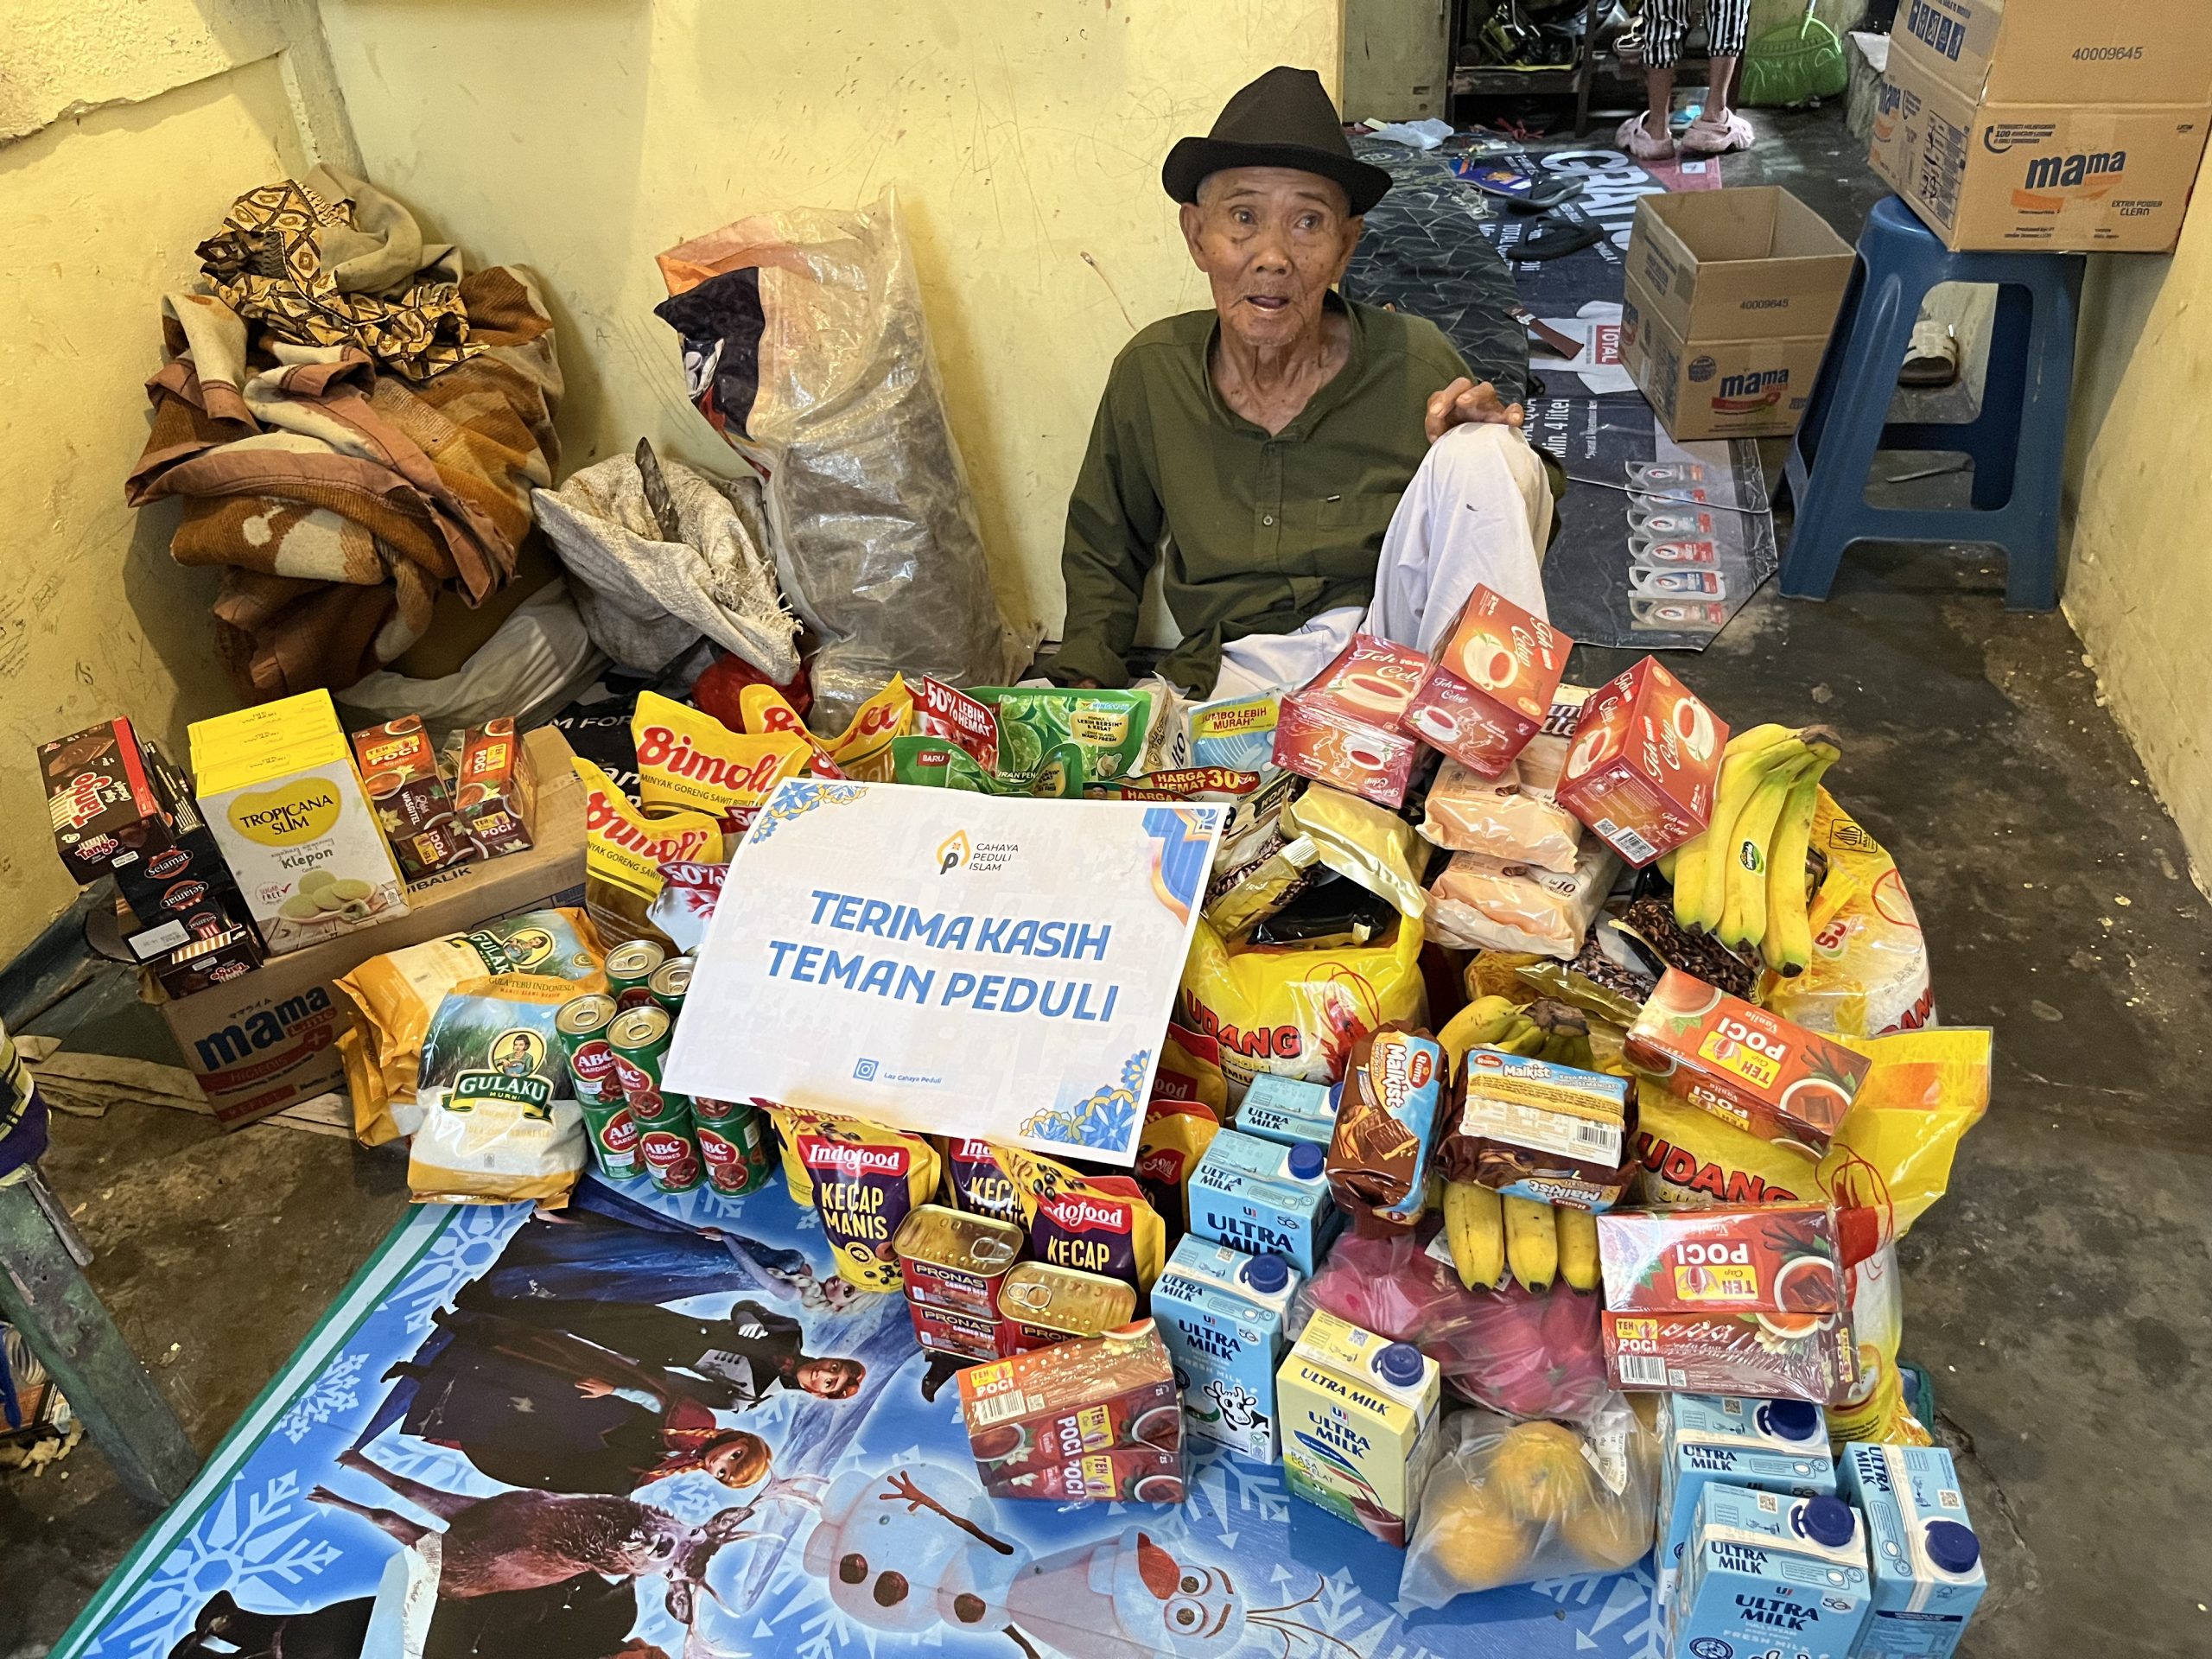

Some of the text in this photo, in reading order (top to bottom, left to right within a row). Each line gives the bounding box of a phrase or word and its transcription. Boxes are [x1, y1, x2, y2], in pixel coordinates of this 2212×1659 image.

[2072, 47, 2143, 60] 40009645
[2024, 150, 2126, 189] mama
[1499, 223, 1522, 245] TOTAL
[1740, 298, 1789, 309] 40009645
[1601, 327, 1620, 363] TOTAL
[1719, 368, 1789, 397] mama
[1353, 650, 1395, 664] Teh
[1433, 678, 1453, 690] Teh
[1441, 690, 1469, 703] Celup
[958, 701, 985, 724] LEBIH
[1202, 707, 1267, 724] JUMBO LEBIH
[368, 746, 388, 756] TEH
[371, 746, 419, 766] POCI
[474, 748, 487, 774] POCI
[922, 753, 945, 763] BARU
[640, 773, 672, 790] MINYAK
[674, 784, 709, 800] GORENG
[1157, 770, 1206, 783] HARGA
[71, 772, 113, 830] Tango
[1128, 790, 1173, 801] HARGA
[239, 794, 334, 829] TROPICANA
[400, 791, 422, 826] WASGITEL
[271, 815, 310, 836] SLIM
[474, 817, 488, 827] TEH
[480, 824, 512, 838] POCI
[75, 838, 118, 861] Tango
[428, 830, 448, 857] POCI
[976, 842, 1019, 852] CAHAYA
[281, 849, 334, 870] Klepon
[588, 842, 640, 872] NYAK GORENG
[969, 862, 1002, 872] ISLAM
[973, 853, 1012, 861] PEDULI
[665, 864, 727, 887] 50%
[260, 885, 279, 896] SUGAR
[263, 892, 283, 901] FREE
[1557, 880, 1576, 894] 10
[808, 890, 1112, 962] TERIMA KASIH
[210, 962, 251, 981] Tango
[767, 940, 1120, 1023] TEMAN PEDULI
[488, 977, 575, 992] GULA TEBU INDONESIA
[194, 986, 332, 1071] mama
[1186, 988, 1303, 1059] UDANG
[1717, 1017, 1787, 1061] POCI
[577, 1048, 613, 1067] ABC
[1477, 1058, 1499, 1066] Roma
[1384, 1043, 1408, 1109] Malkist
[1414, 1054, 1427, 1087] Roma
[1503, 1064, 1552, 1079] Malkist
[1740, 1059, 1772, 1084] TEH
[459, 1076, 548, 1101] GULAKU
[489, 1091, 521, 1101] MURNI
[1694, 1085, 1749, 1120] POCI
[1248, 1107, 1289, 1125] ULTRA
[1248, 1116, 1281, 1130] MILK
[645, 1141, 681, 1154] ABC
[809, 1145, 899, 1173] Indofood
[1640, 1133, 1798, 1202] UDANG
[1199, 1175, 1235, 1192] MILK
[1200, 1165, 1243, 1186] ULTRA
[821, 1181, 884, 1213] KECAP
[970, 1177, 1022, 1210] KECA
[1528, 1180, 1602, 1202] Malkist
[1045, 1199, 1122, 1227] dofood
[823, 1211, 888, 1241] MANIS
[1207, 1212, 1294, 1253] ULTRA
[1047, 1236, 1110, 1268] KECAP
[1677, 1243, 1749, 1266] POCI
[916, 1264, 985, 1288] PRONAS
[1162, 1274, 1203, 1297] ULTRA
[1722, 1279, 1756, 1295] TEH
[1160, 1285, 1195, 1303] MILK
[925, 1310, 992, 1332] PRONAS
[1617, 1319, 1634, 1331] TEH
[1179, 1319, 1242, 1353] ULTRA
[1619, 1338, 1658, 1354] POCI
[1187, 1336, 1235, 1362] MILK
[973, 1370, 990, 1380] TEH
[976, 1379, 1014, 1397] POCI
[1301, 1367, 1389, 1417] ULTRA MILK
[1090, 1407, 1106, 1426] TEH
[1057, 1415, 1082, 1457] POCI
[1308, 1410, 1370, 1451] ULTRA
[1316, 1427, 1365, 1460] MILK
[1682, 1445, 1736, 1463] ULTRA
[1093, 1457, 1109, 1475] TEH
[1291, 1452, 1318, 1471] RASA
[1691, 1457, 1733, 1471] MILK
[1853, 1449, 1875, 1485] MILK
[1868, 1446, 1891, 1492] ULTRA
[1064, 1459, 1086, 1496] POCI
[1711, 1541, 1766, 1564] ULTRA
[1718, 1555, 1763, 1575] MILK
[1735, 1593, 1819, 1623] ULTRA
[1740, 1608, 1808, 1632] MILK
[1723, 1629, 1811, 1652] FRESH MILK
